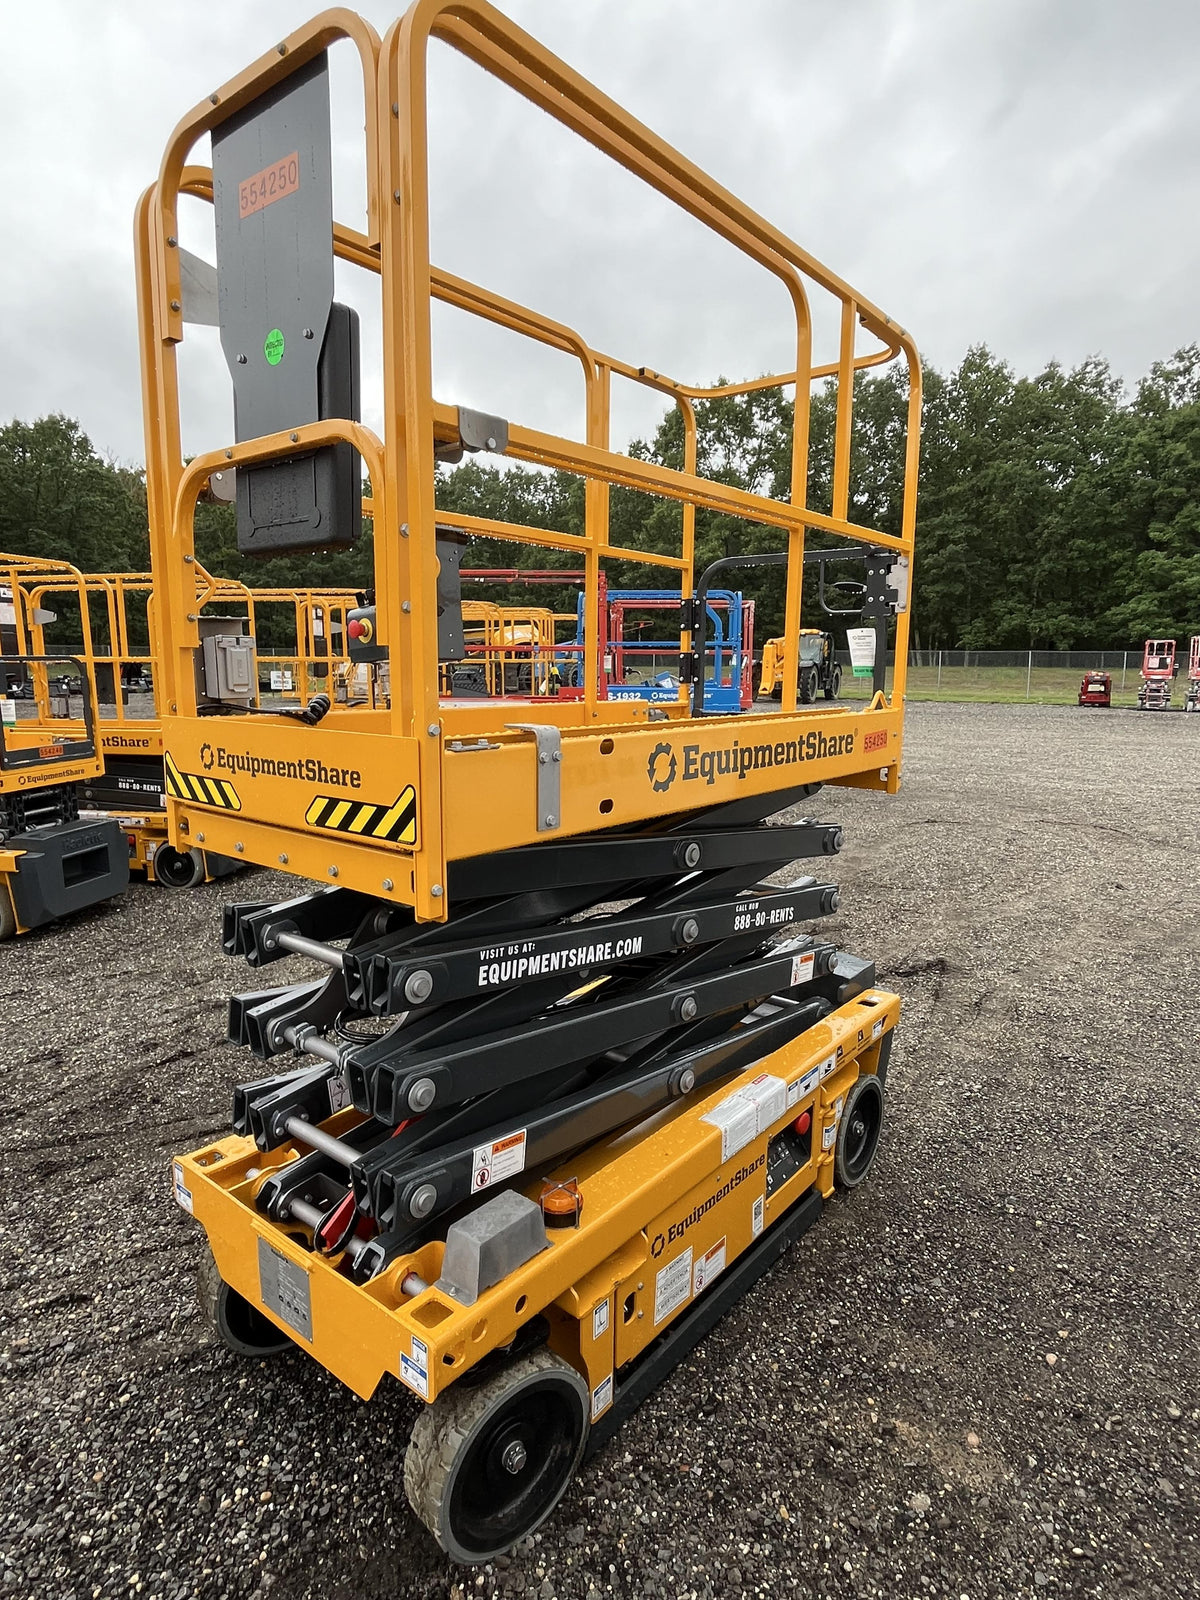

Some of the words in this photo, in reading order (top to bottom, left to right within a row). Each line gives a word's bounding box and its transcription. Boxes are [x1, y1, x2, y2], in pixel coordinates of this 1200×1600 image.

[240, 160, 297, 211] 554250
[682, 731, 854, 785] EquipmentShare
[864, 732, 887, 750] 554250
[26, 768, 85, 783] EquipmentShare
[216, 747, 361, 789] EquipmentShare
[734, 906, 795, 931] 888-80-RENTS
[478, 936, 643, 986] EQUIPMENTSHARE.COM
[479, 947, 505, 961] VISIT
[507, 944, 519, 956] US
[522, 942, 536, 953] AT:
[667, 1153, 765, 1245] EquipmentShare
